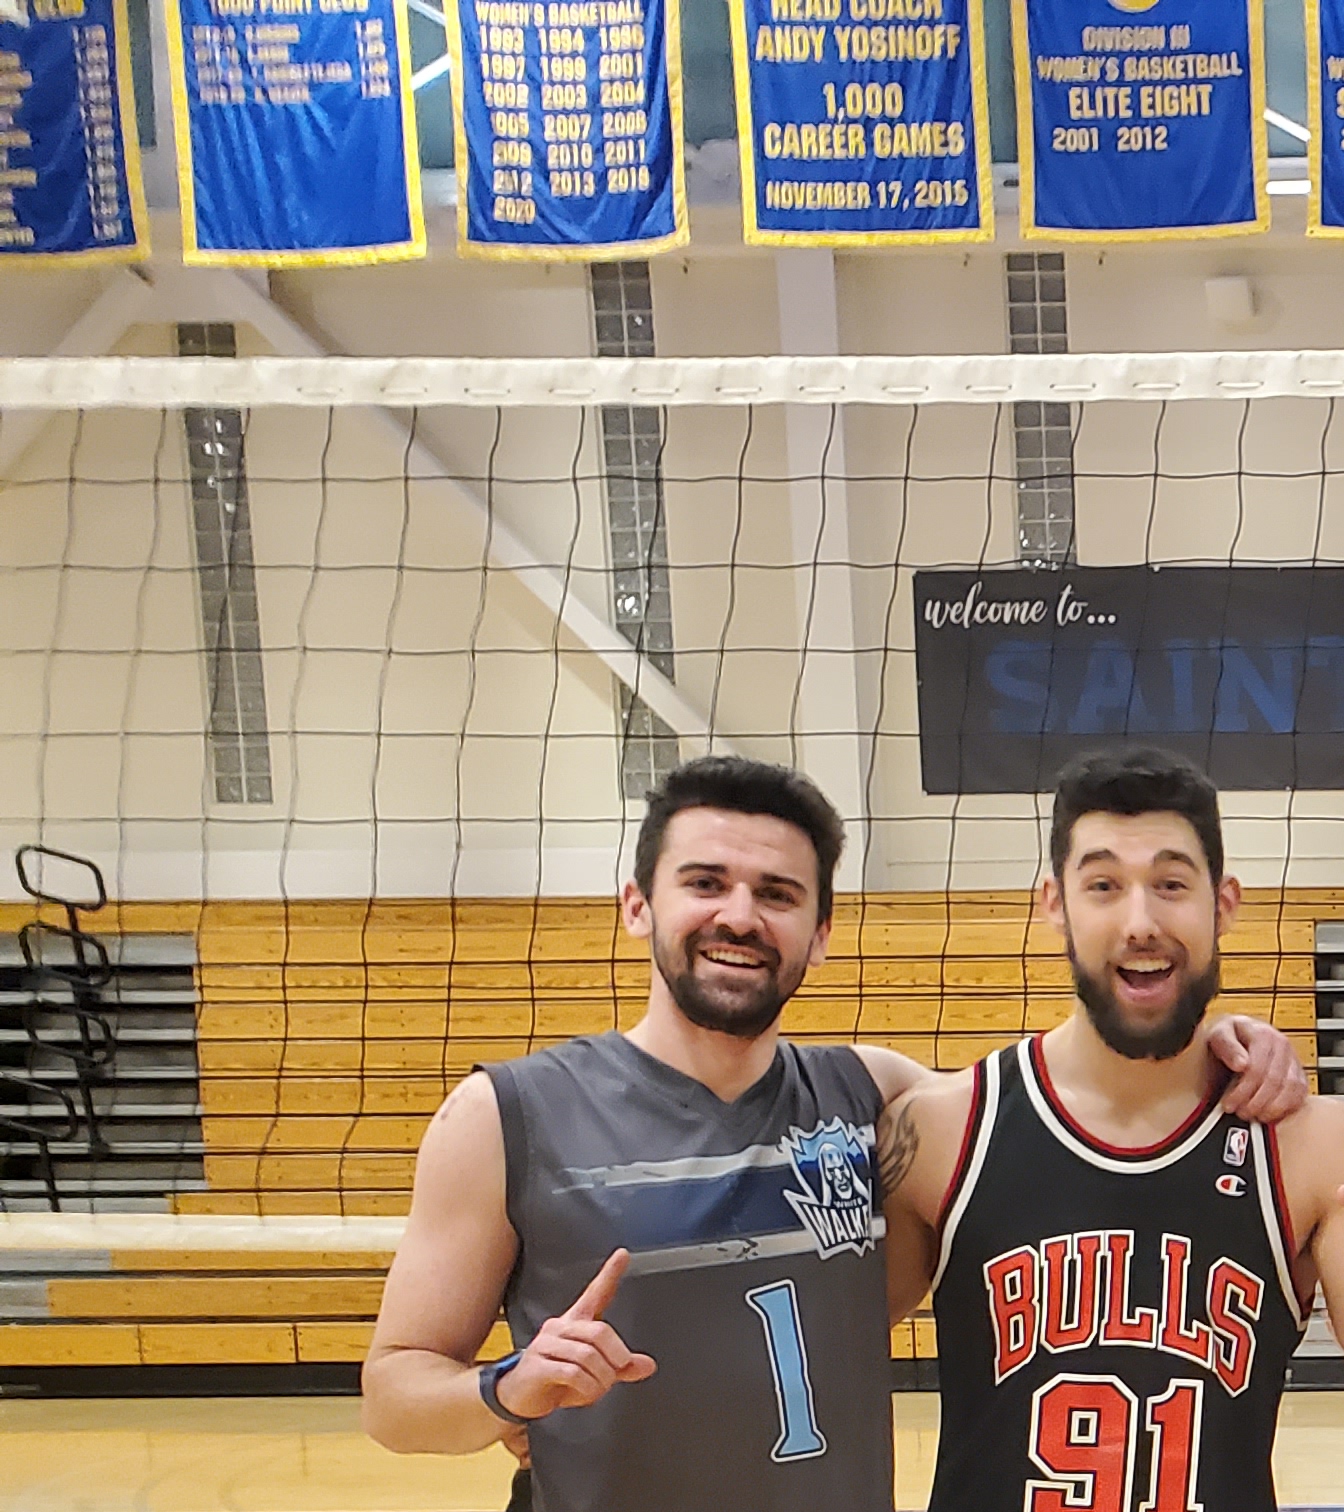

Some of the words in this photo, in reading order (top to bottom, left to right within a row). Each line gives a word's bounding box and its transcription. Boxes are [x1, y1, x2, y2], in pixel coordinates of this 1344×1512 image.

[755, 25, 826, 63] ANDY
[834, 24, 961, 63] YOSINOFF
[599, 52, 643, 80] 2001
[1037, 55, 1119, 82] WOMEN'S
[1124, 52, 1242, 81] BASKETBALL
[822, 82, 903, 124] 1,000
[1069, 86, 1132, 120] ELITE
[1140, 84, 1212, 119] EIGHT
[544, 113, 592, 141] 2007
[764, 122, 866, 159] CAREER
[874, 122, 965, 159] GAMES
[1053, 126, 1099, 152] 2001
[1117, 125, 1168, 152] 2012
[604, 139, 645, 166] 2011
[765, 181, 871, 210] NOVEMBER
[876, 181, 910, 212] 17,
[923, 581, 1047, 628] welcome
[983, 1229, 1264, 1397] BULLS
[745, 1278, 827, 1462] 1
